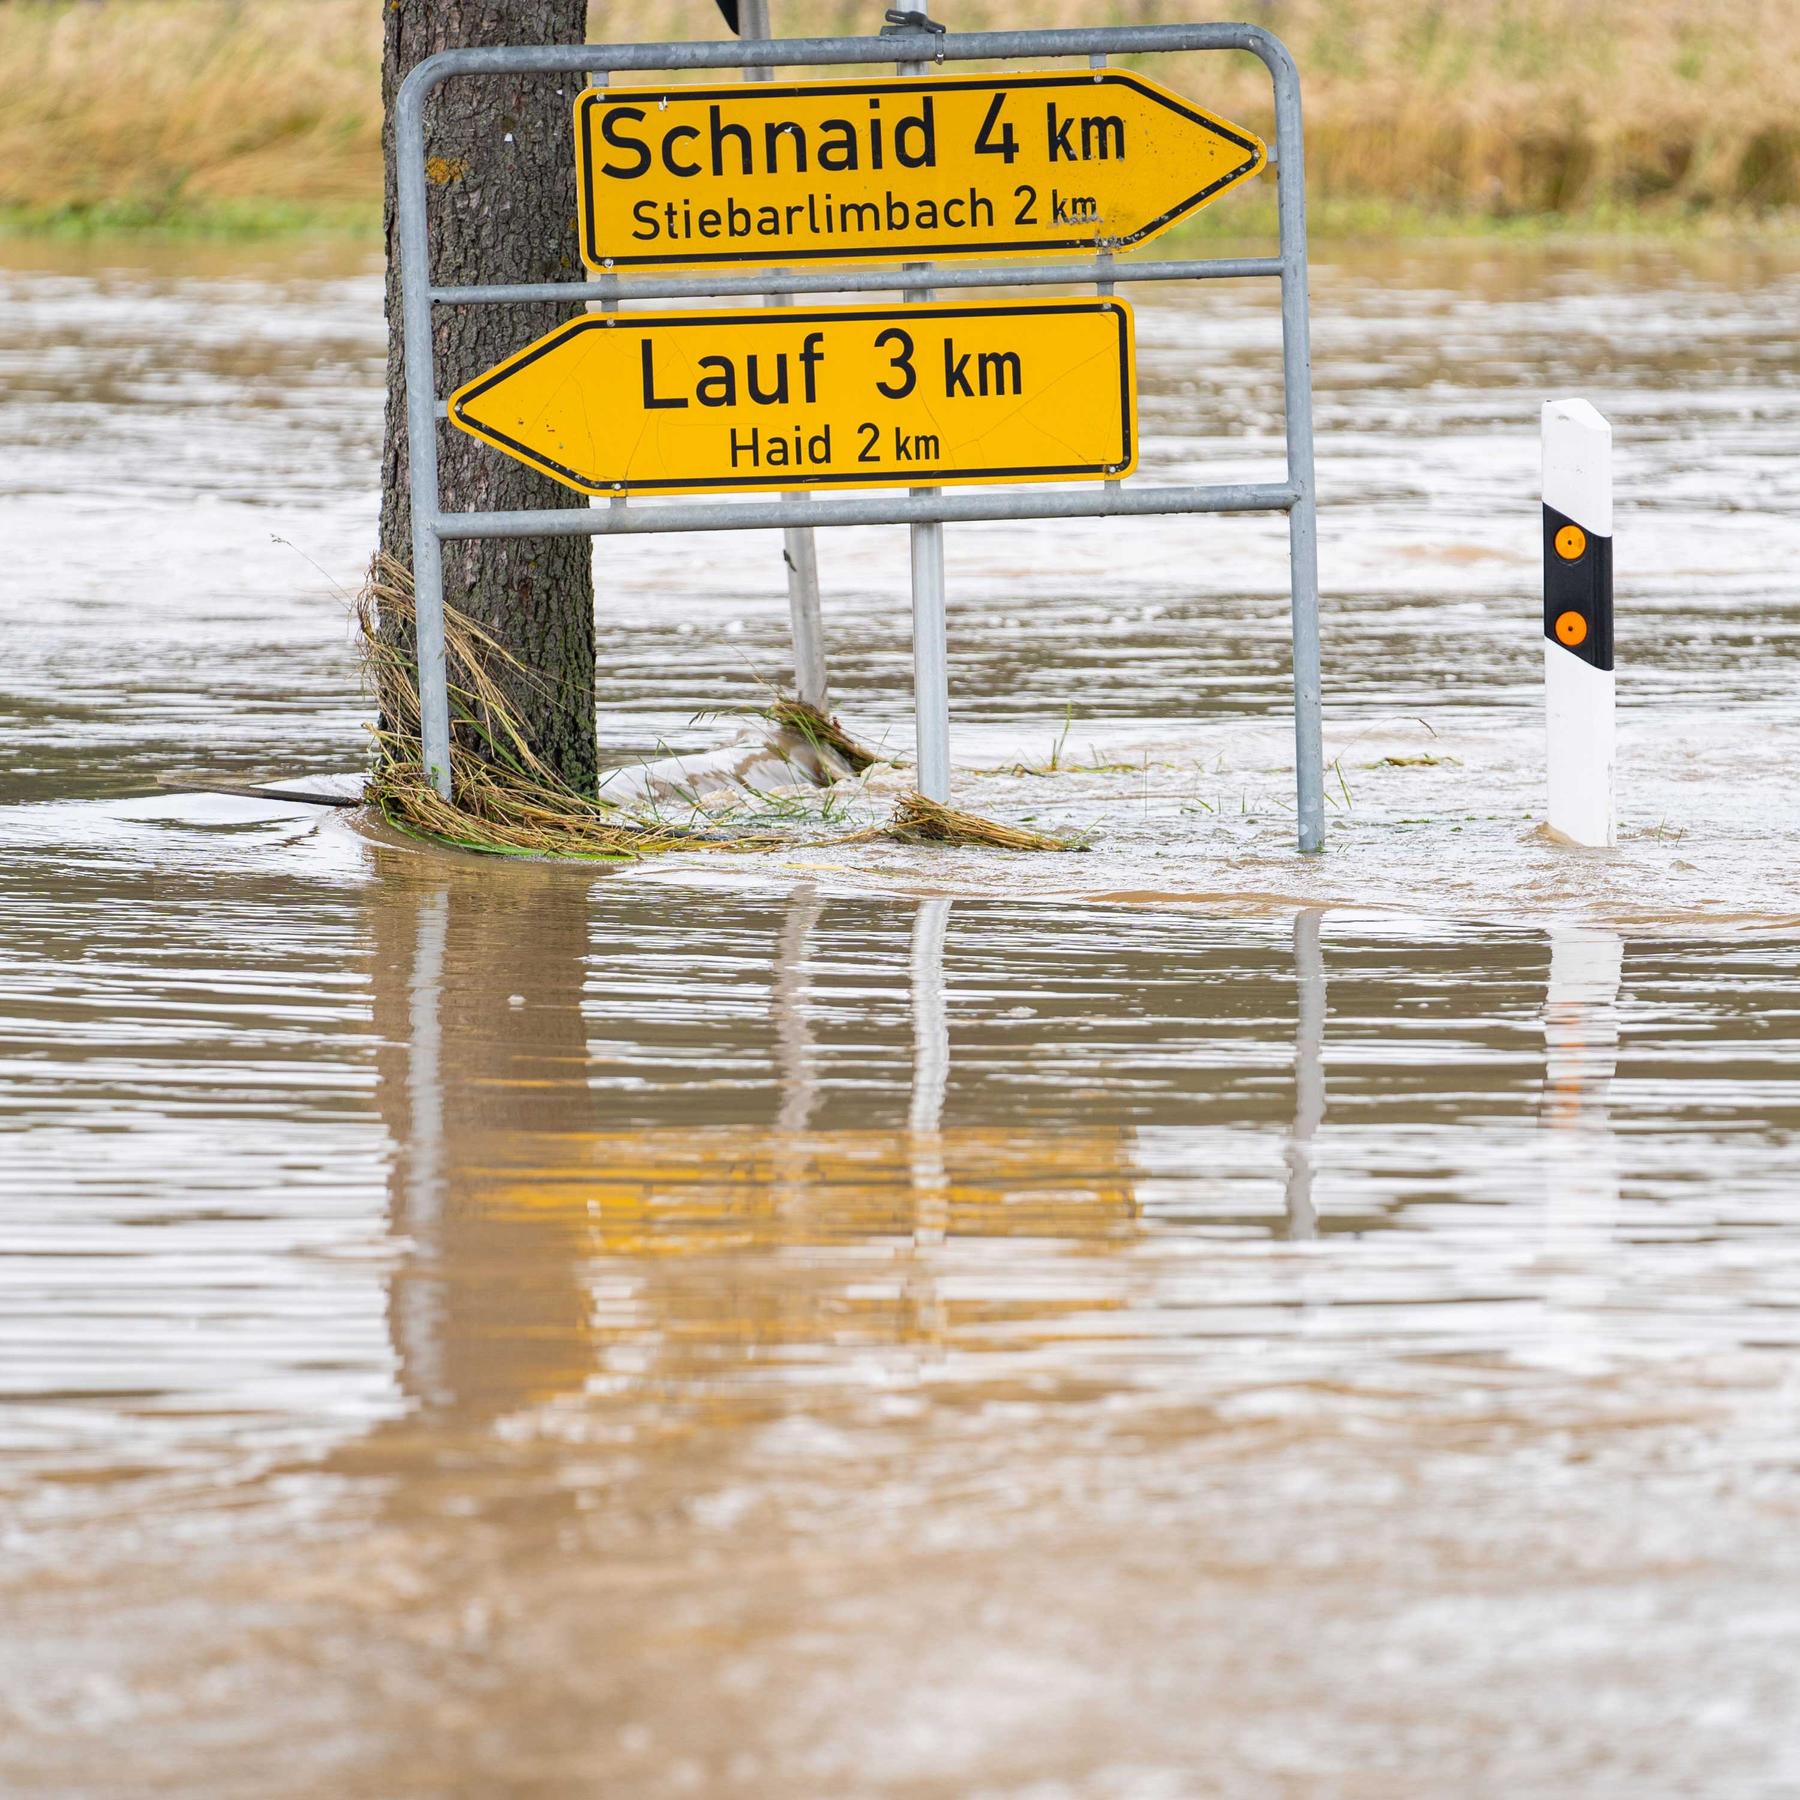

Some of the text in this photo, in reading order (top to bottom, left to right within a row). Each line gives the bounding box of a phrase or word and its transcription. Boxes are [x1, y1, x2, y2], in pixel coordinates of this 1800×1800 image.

[601, 92, 1125, 180] Schnaid 4 km
[631, 184, 1098, 241] Stiebarlimbach 2 km
[641, 327, 1022, 410] Lauf 3 km
[730, 422, 940, 468] Haid 2 km
